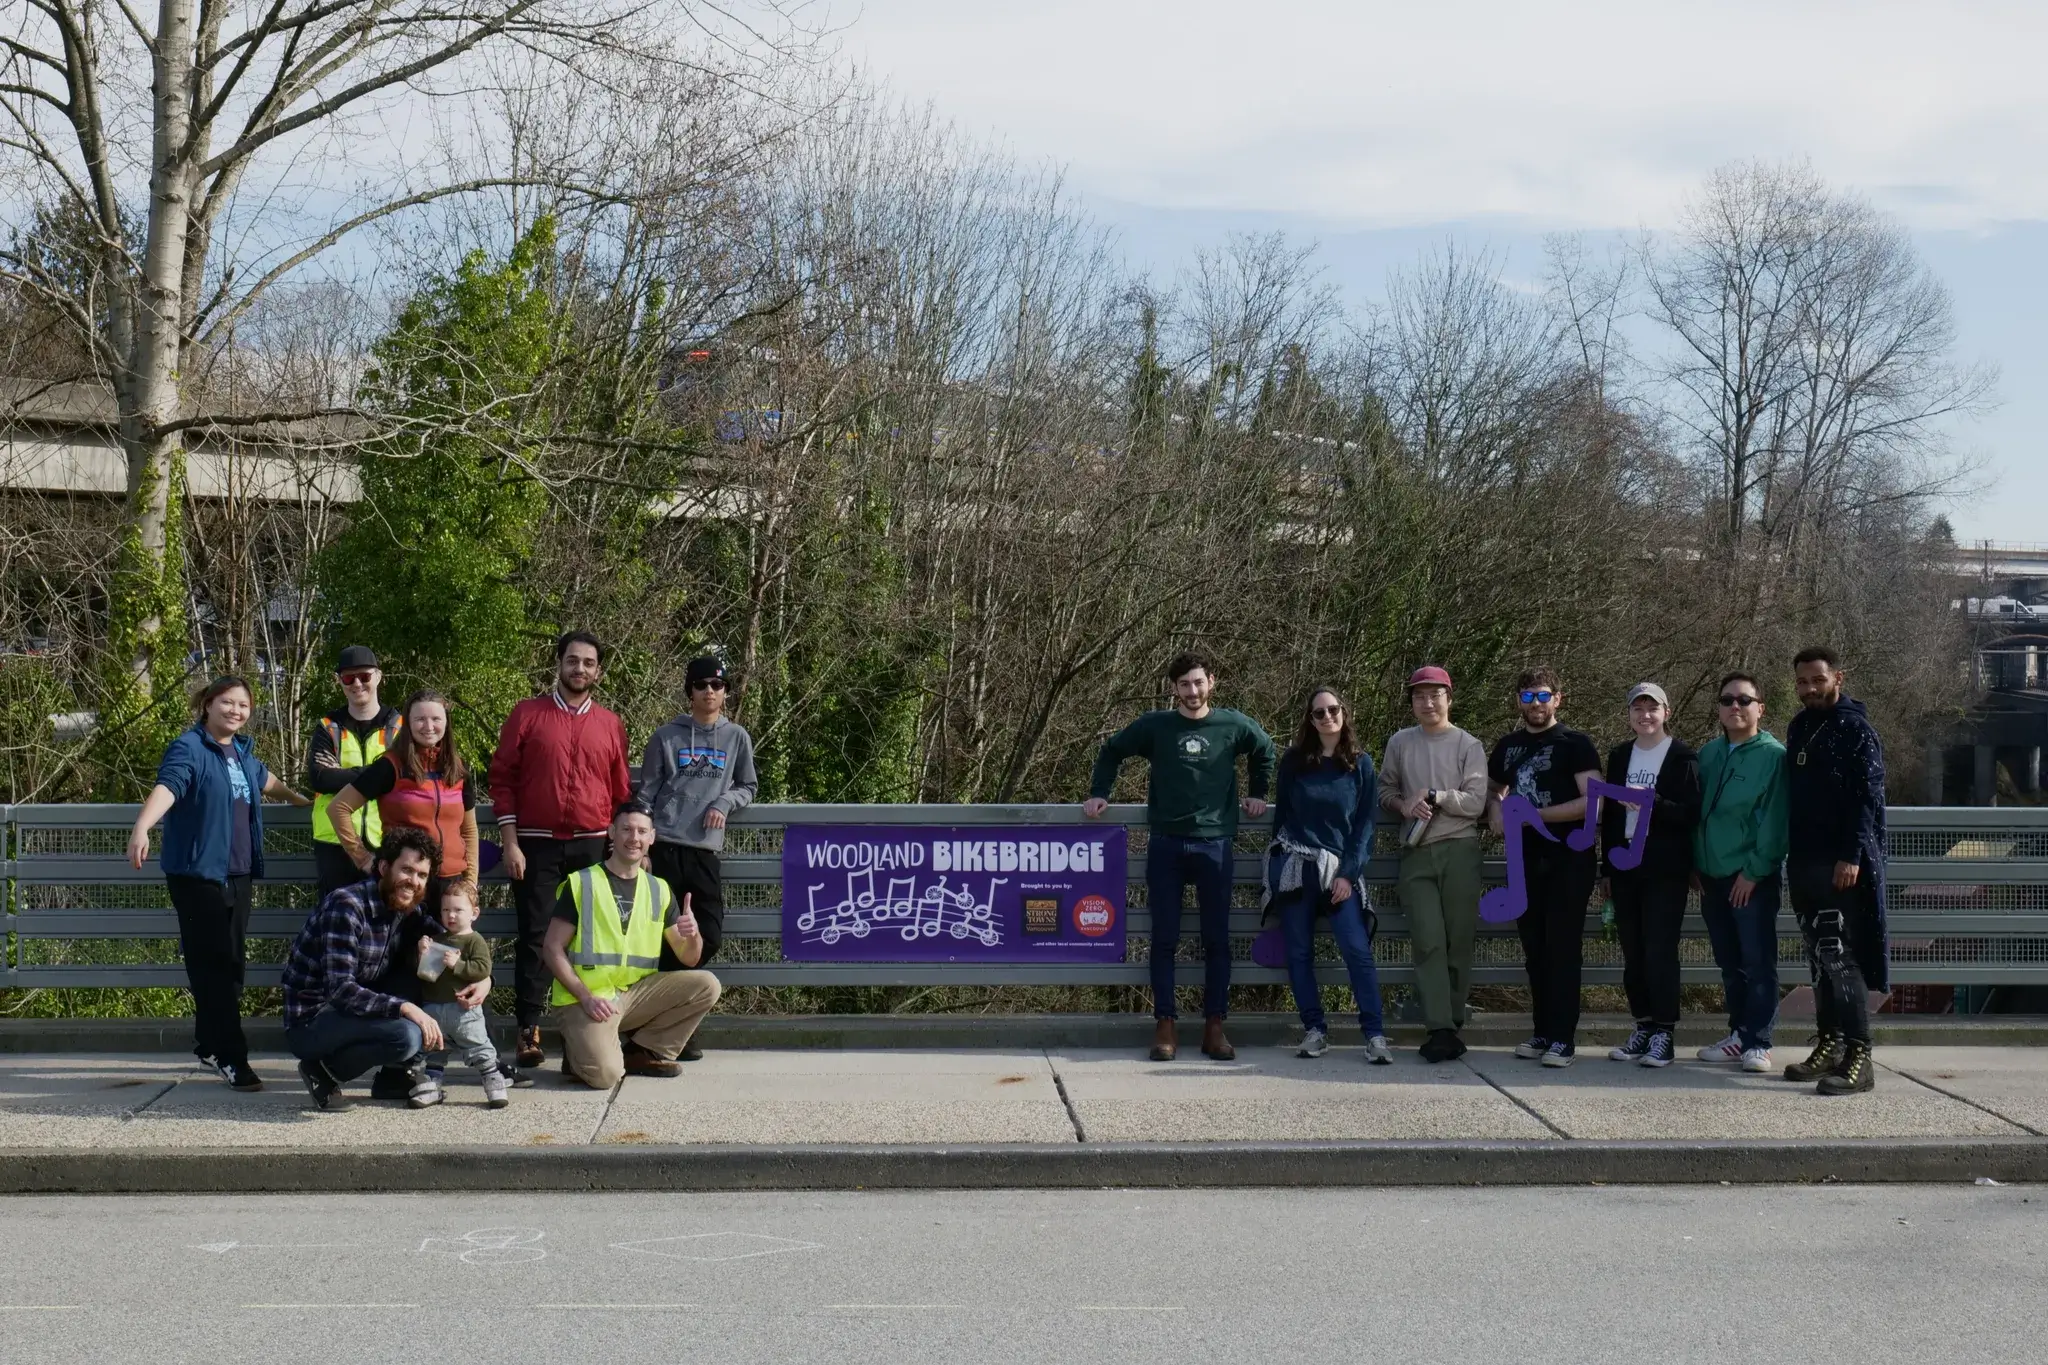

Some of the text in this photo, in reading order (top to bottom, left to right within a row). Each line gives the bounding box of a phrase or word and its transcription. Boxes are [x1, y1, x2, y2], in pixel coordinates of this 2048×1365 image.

[679, 769, 722, 779] patagonia
[806, 840, 1105, 872] WOODLAND BIKEBRIDGE
